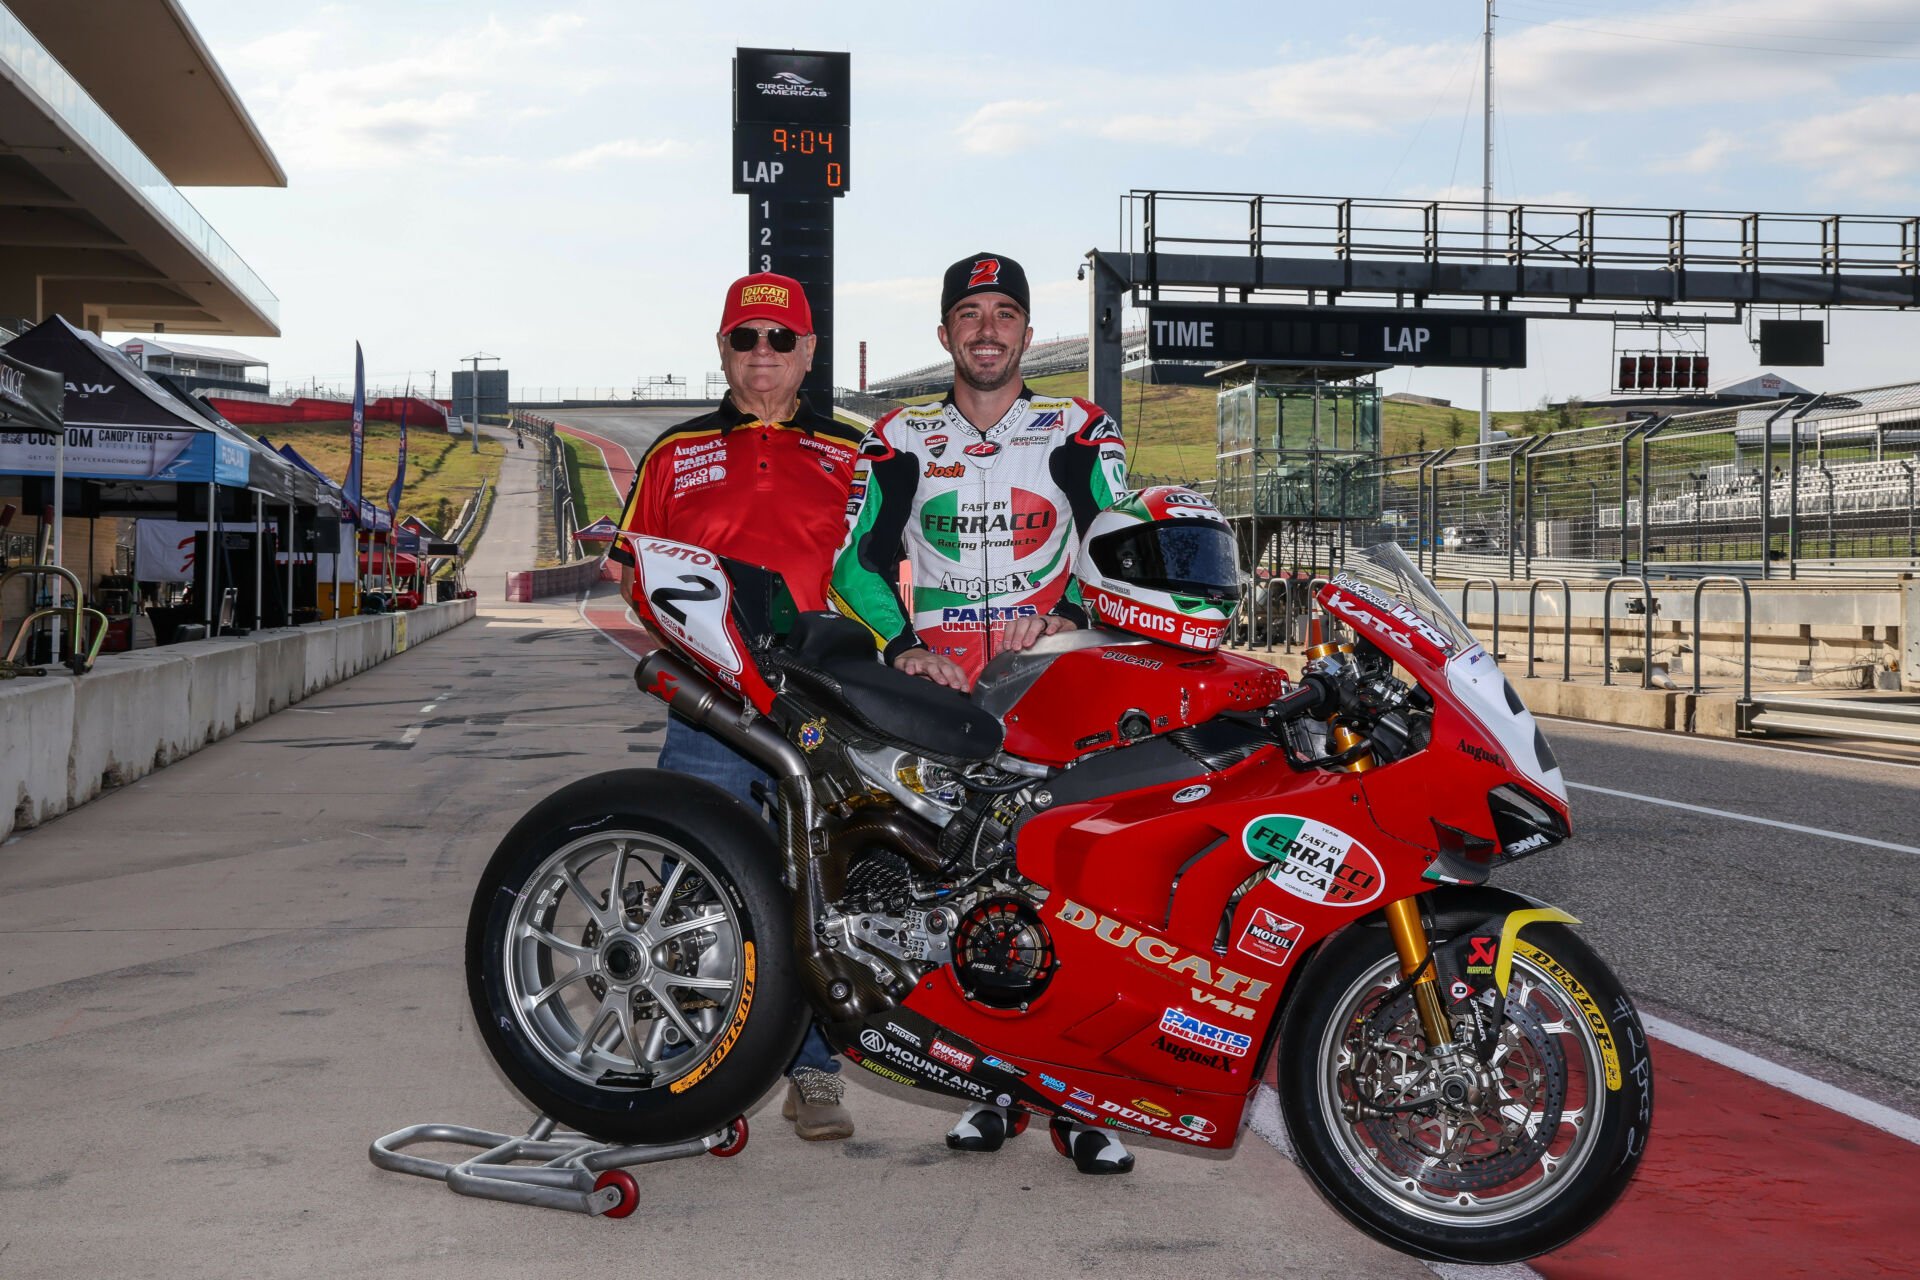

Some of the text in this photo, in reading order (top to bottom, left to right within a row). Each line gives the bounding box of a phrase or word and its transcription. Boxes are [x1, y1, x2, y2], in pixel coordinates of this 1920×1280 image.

[762, 89, 827, 97] AMERICAS
[773, 129, 832, 153] 9:04
[742, 161, 784, 183] LAP
[827, 163, 841, 186] 0
[761, 201, 769, 218] 1
[761, 228, 771, 245] 2
[761, 255, 771, 273] 3
[968, 258, 1000, 289] 2
[743, 295, 786, 305] NEW YORK
[744, 286, 786, 298] DUCATI
[1152, 321, 1214, 347] TIME
[1384, 327, 1430, 353] LAP
[98, 430, 134, 443] CANOPY
[674, 450, 727, 468] PARTS
[924, 462, 966, 478] Josh
[674, 476, 708, 491] HORSE
[675, 468, 708, 485] MOTO
[961, 501, 1009, 512] FAST BY
[924, 511, 1050, 533] FERRACCI
[644, 542, 712, 566] KATO
[937, 537, 1038, 550] Racing Products
[651, 574, 722, 626] 2
[1331, 573, 1390, 610] Josh Herrin
[942, 605, 1037, 622] PARTS
[1098, 593, 1176, 633] OnlyFans
[1390, 604, 1453, 649] WRS
[1102, 650, 1163, 671] DUCATI
[1300, 833, 1345, 856] FAST BY
[1322, 828, 1339, 838] TEAM
[1253, 826, 1375, 889] FERRACCI
[1285, 882, 1313, 898] CORSE USA
[1251, 925, 1290, 949] MOTUL
[1055, 899, 1272, 1002] DUCATI
[1191, 987, 1257, 1021] V4R
[1530, 953, 1612, 1050] DUNLOP
[698, 976, 754, 1082] DUNLOP
[1163, 1008, 1251, 1049] PARTS
[1470, 998, 1487, 1042] SPIEGLER
[885, 1021, 918, 1045] SPIDER
[1160, 1021, 1247, 1057] UNLIMITED
[930, 1049, 970, 1072] NEW YORK
[932, 1041, 974, 1065] DUCATI
[885, 1054, 987, 1101] CASINO RESORT SPA
[886, 1042, 993, 1096] MOUNT AIRY
[1098, 1100, 1211, 1141] DUNLOP
